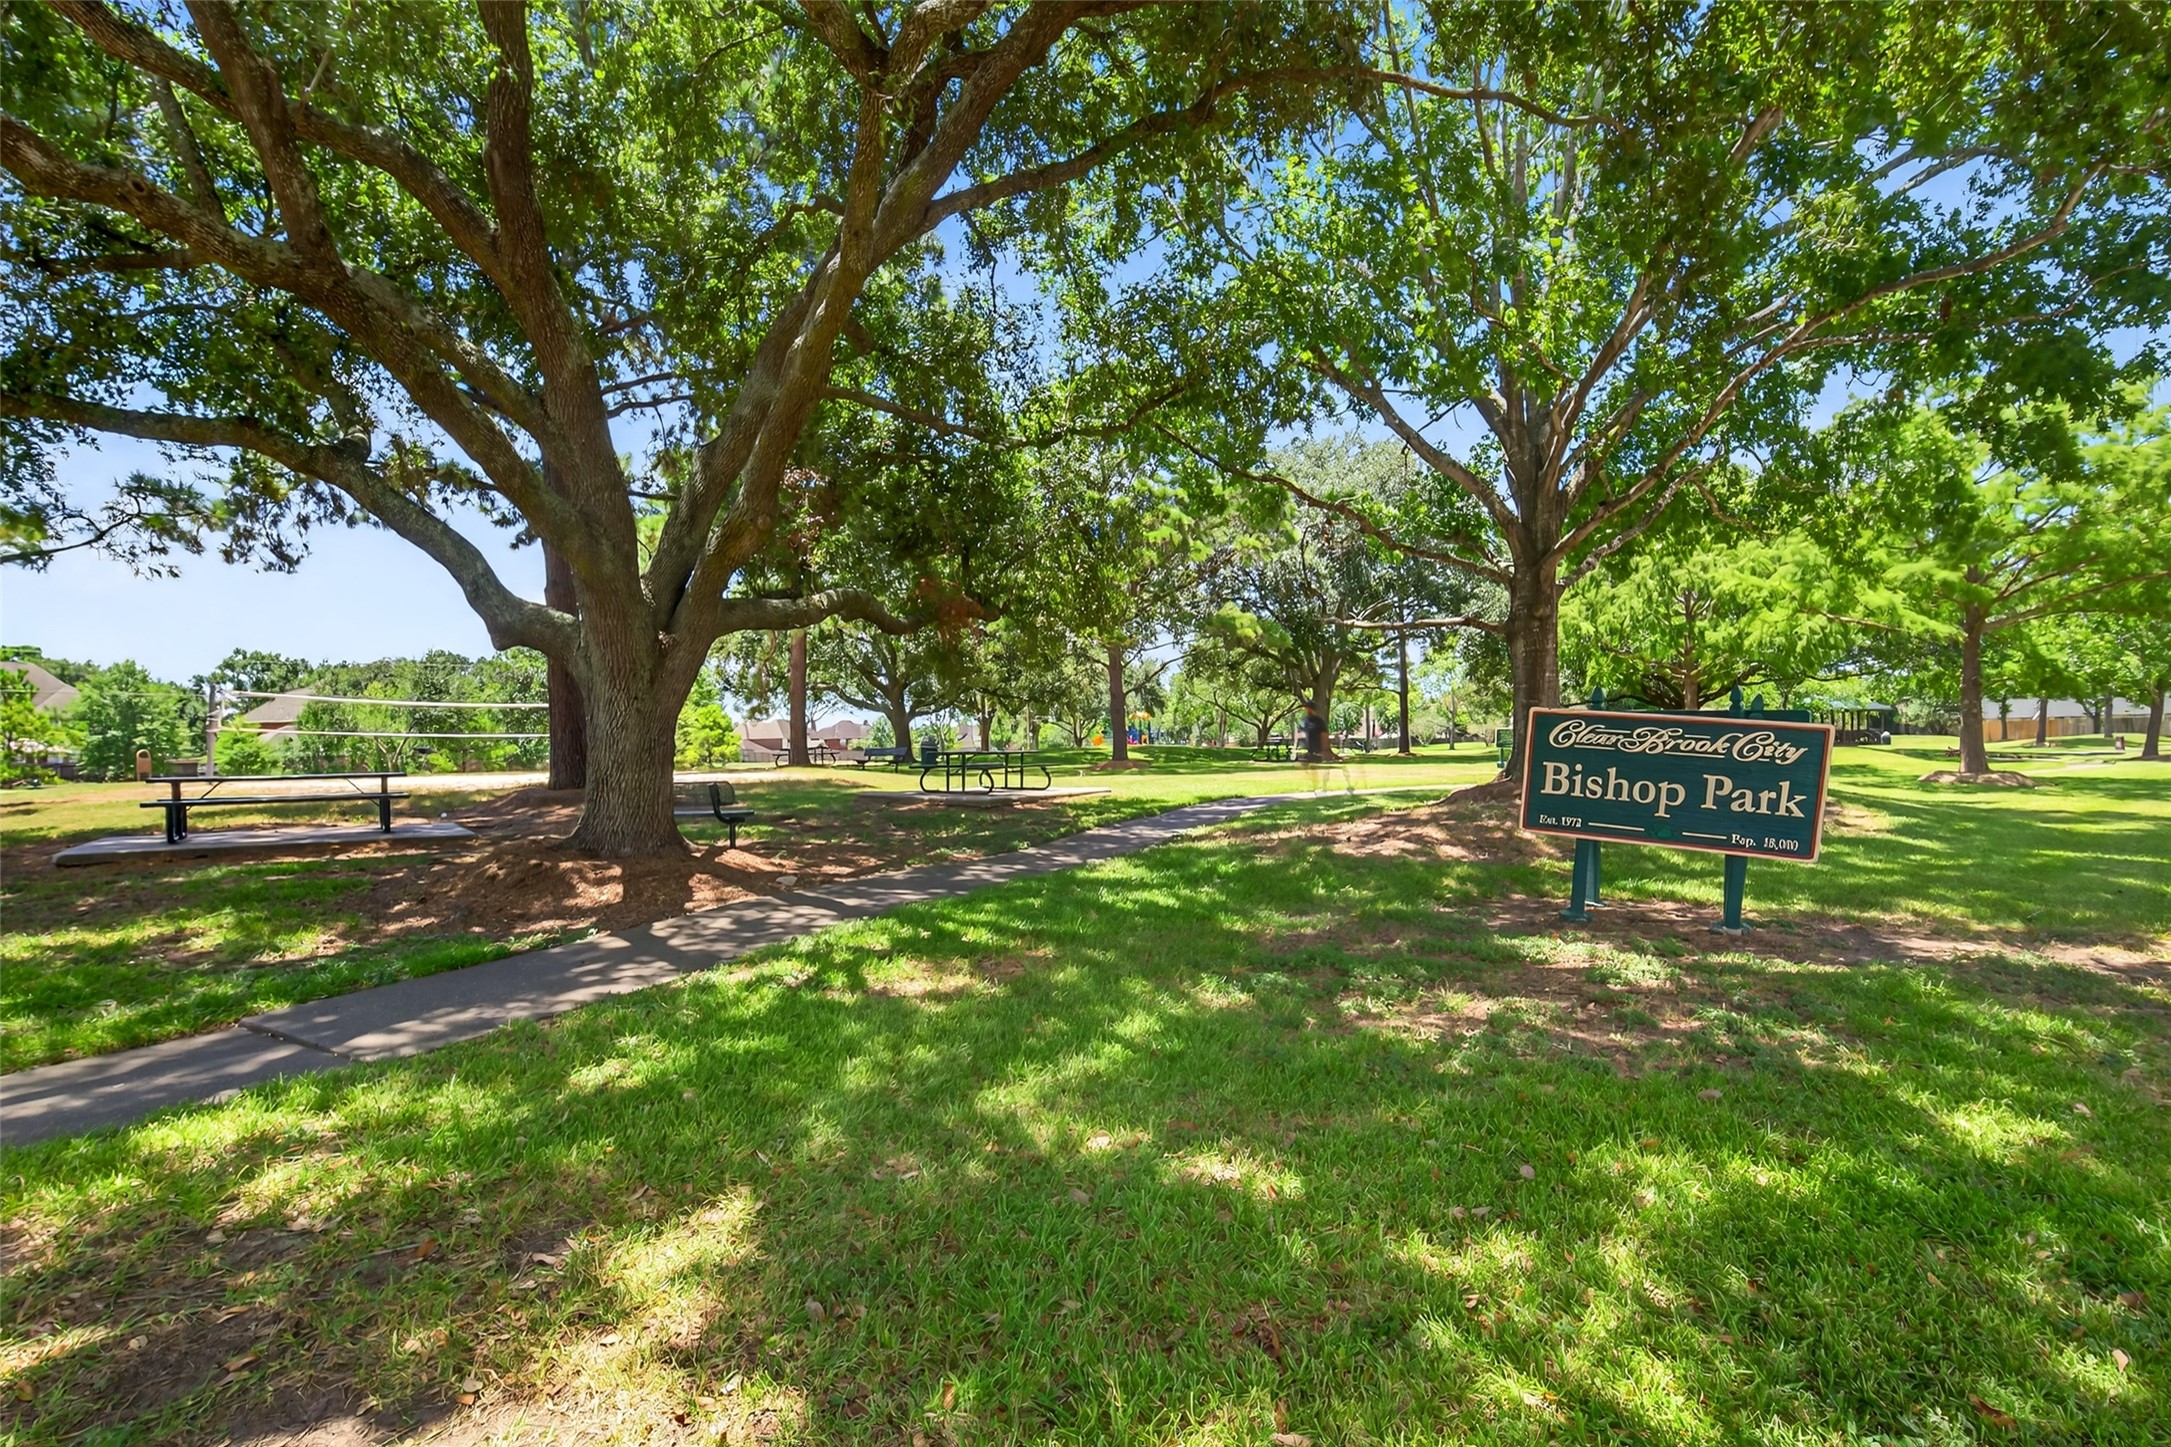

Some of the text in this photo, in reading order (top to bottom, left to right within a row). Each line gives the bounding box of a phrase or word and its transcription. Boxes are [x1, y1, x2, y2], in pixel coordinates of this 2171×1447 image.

[1549, 719, 1808, 765] Clear Brook City
[1540, 761, 1807, 818] Bishop Park
[1731, 833, 1756, 848] Pop.
